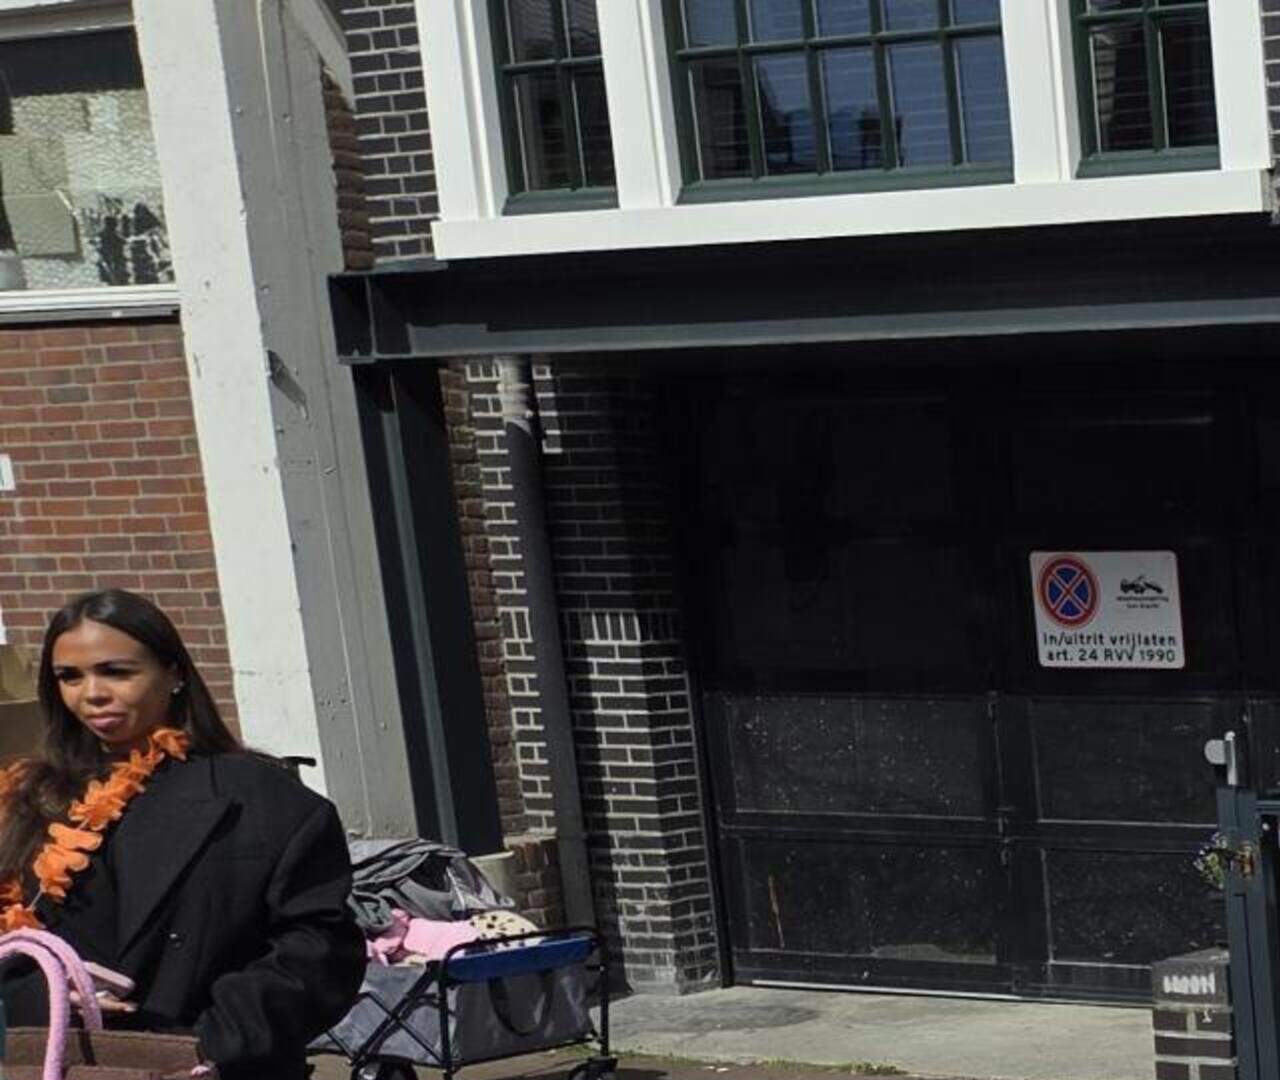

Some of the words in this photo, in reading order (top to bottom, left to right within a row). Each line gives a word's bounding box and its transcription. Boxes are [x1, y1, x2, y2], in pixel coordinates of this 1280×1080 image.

[1110, 632, 1177, 650] vrijlaten
[1047, 650, 1073, 662] art.
[1078, 650, 1098, 661] 24
[1104, 648, 1135, 661] RVV
[1139, 650, 1176, 663] 1990
